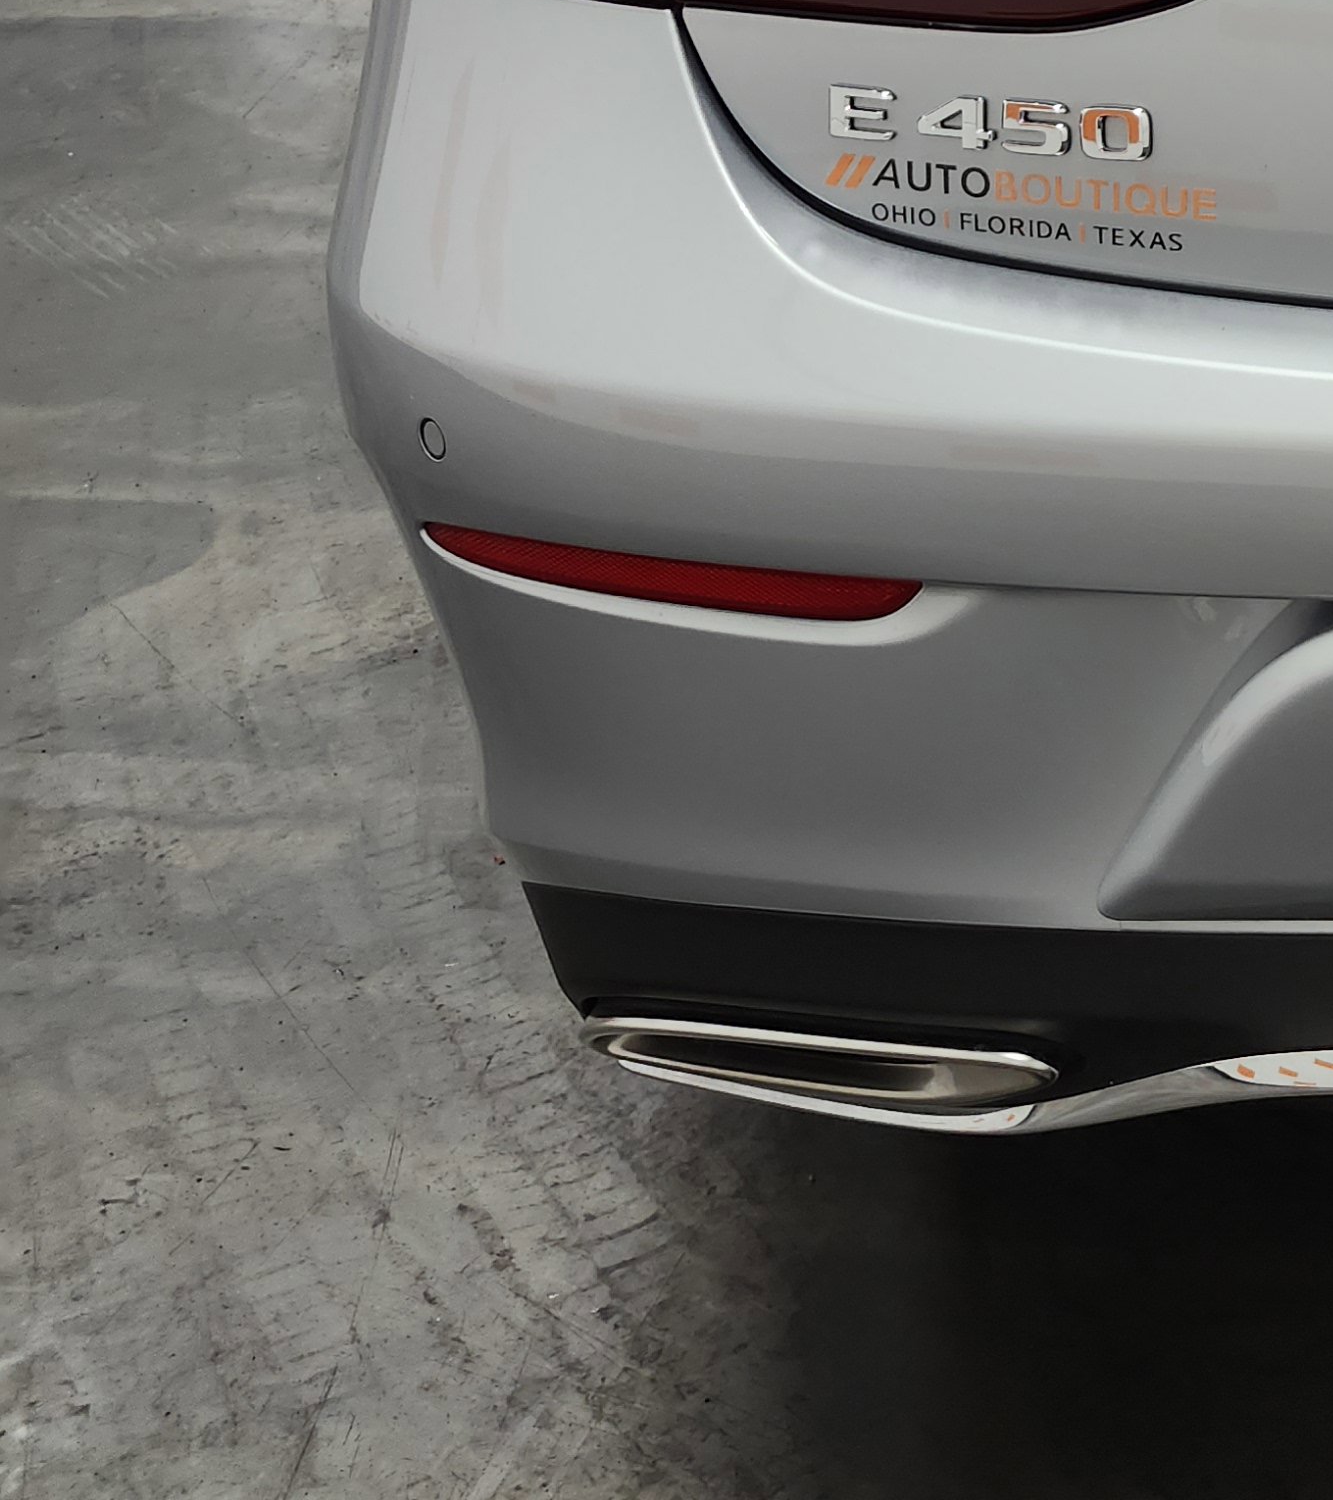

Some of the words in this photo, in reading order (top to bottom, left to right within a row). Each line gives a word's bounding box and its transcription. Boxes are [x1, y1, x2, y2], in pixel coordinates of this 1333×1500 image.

[829, 83, 898, 142] E
[917, 94, 1154, 162] 450
[871, 202, 937, 228] OHIO
[959, 212, 1073, 242] FLORIDA
[1092, 224, 1184, 252] TEXAS
